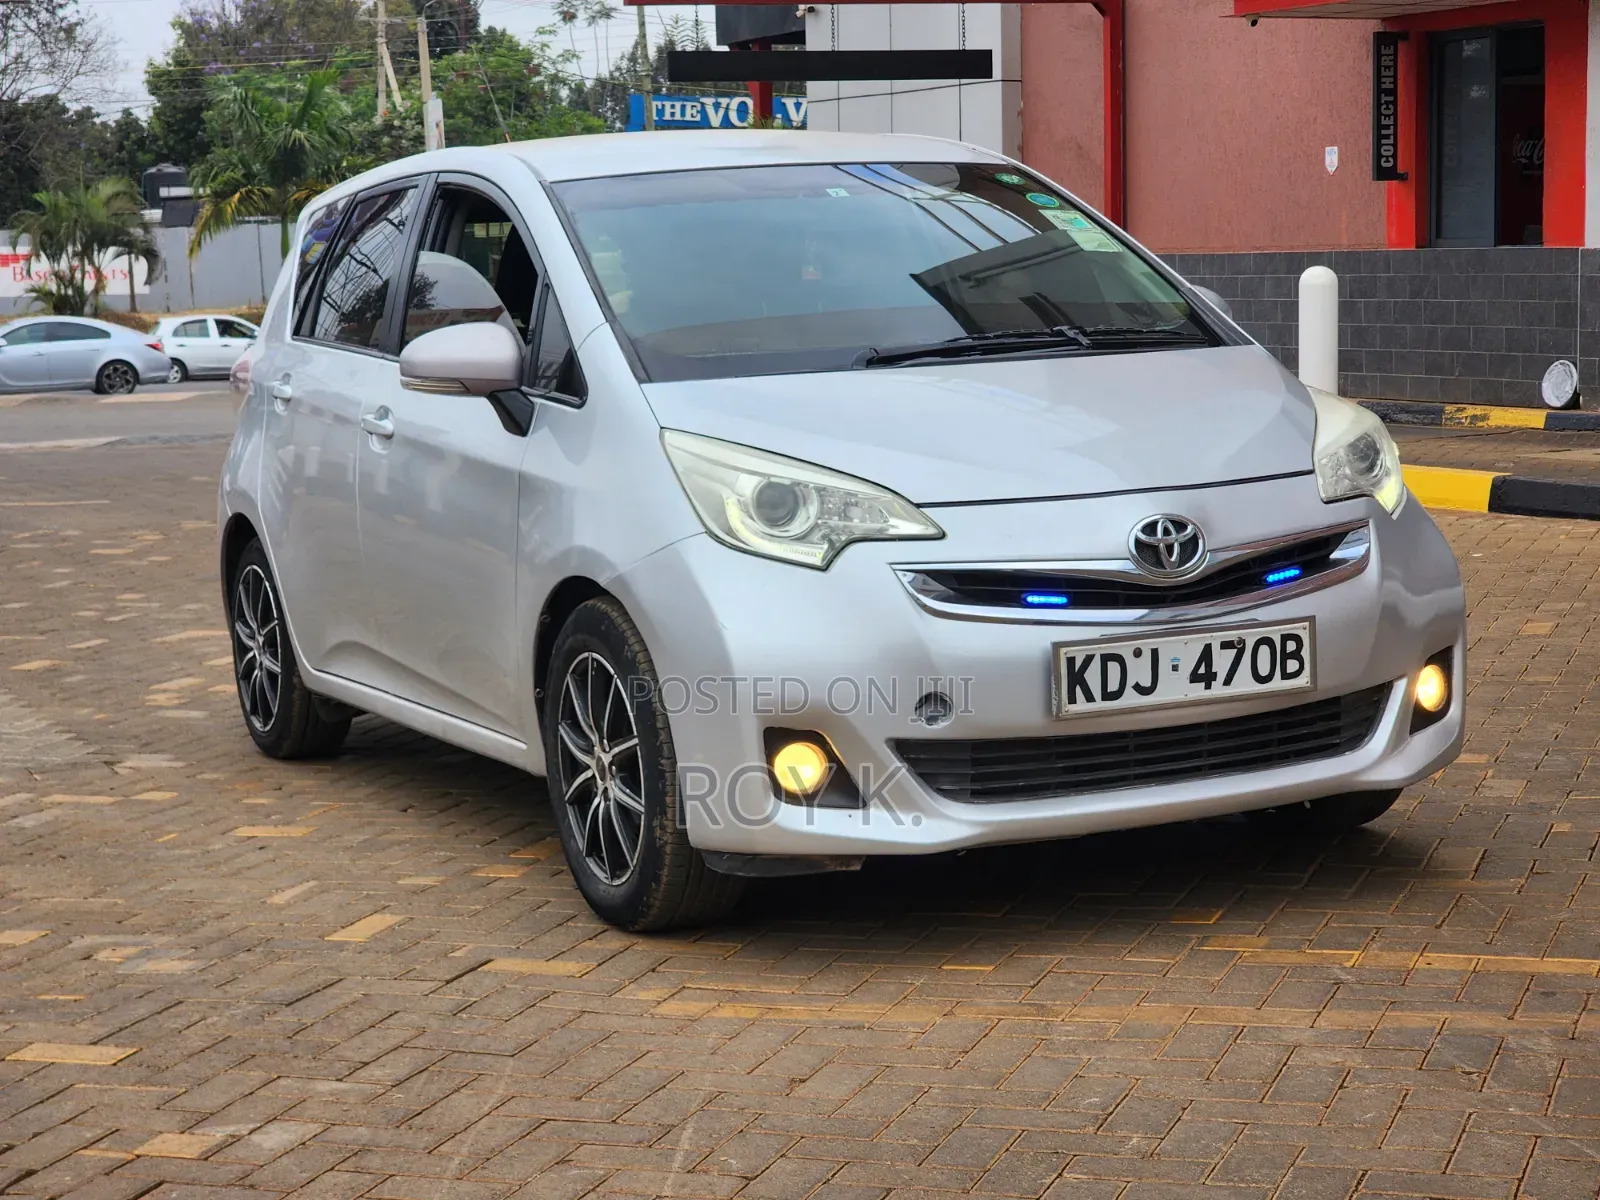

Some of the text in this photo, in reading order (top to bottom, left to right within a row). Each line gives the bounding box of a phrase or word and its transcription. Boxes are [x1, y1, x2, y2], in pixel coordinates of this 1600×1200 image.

[652, 96, 808, 128] THE VOV
[1380, 44, 1395, 168] COLLECT HERE
[1066, 633, 1305, 705] KDJ 470B
